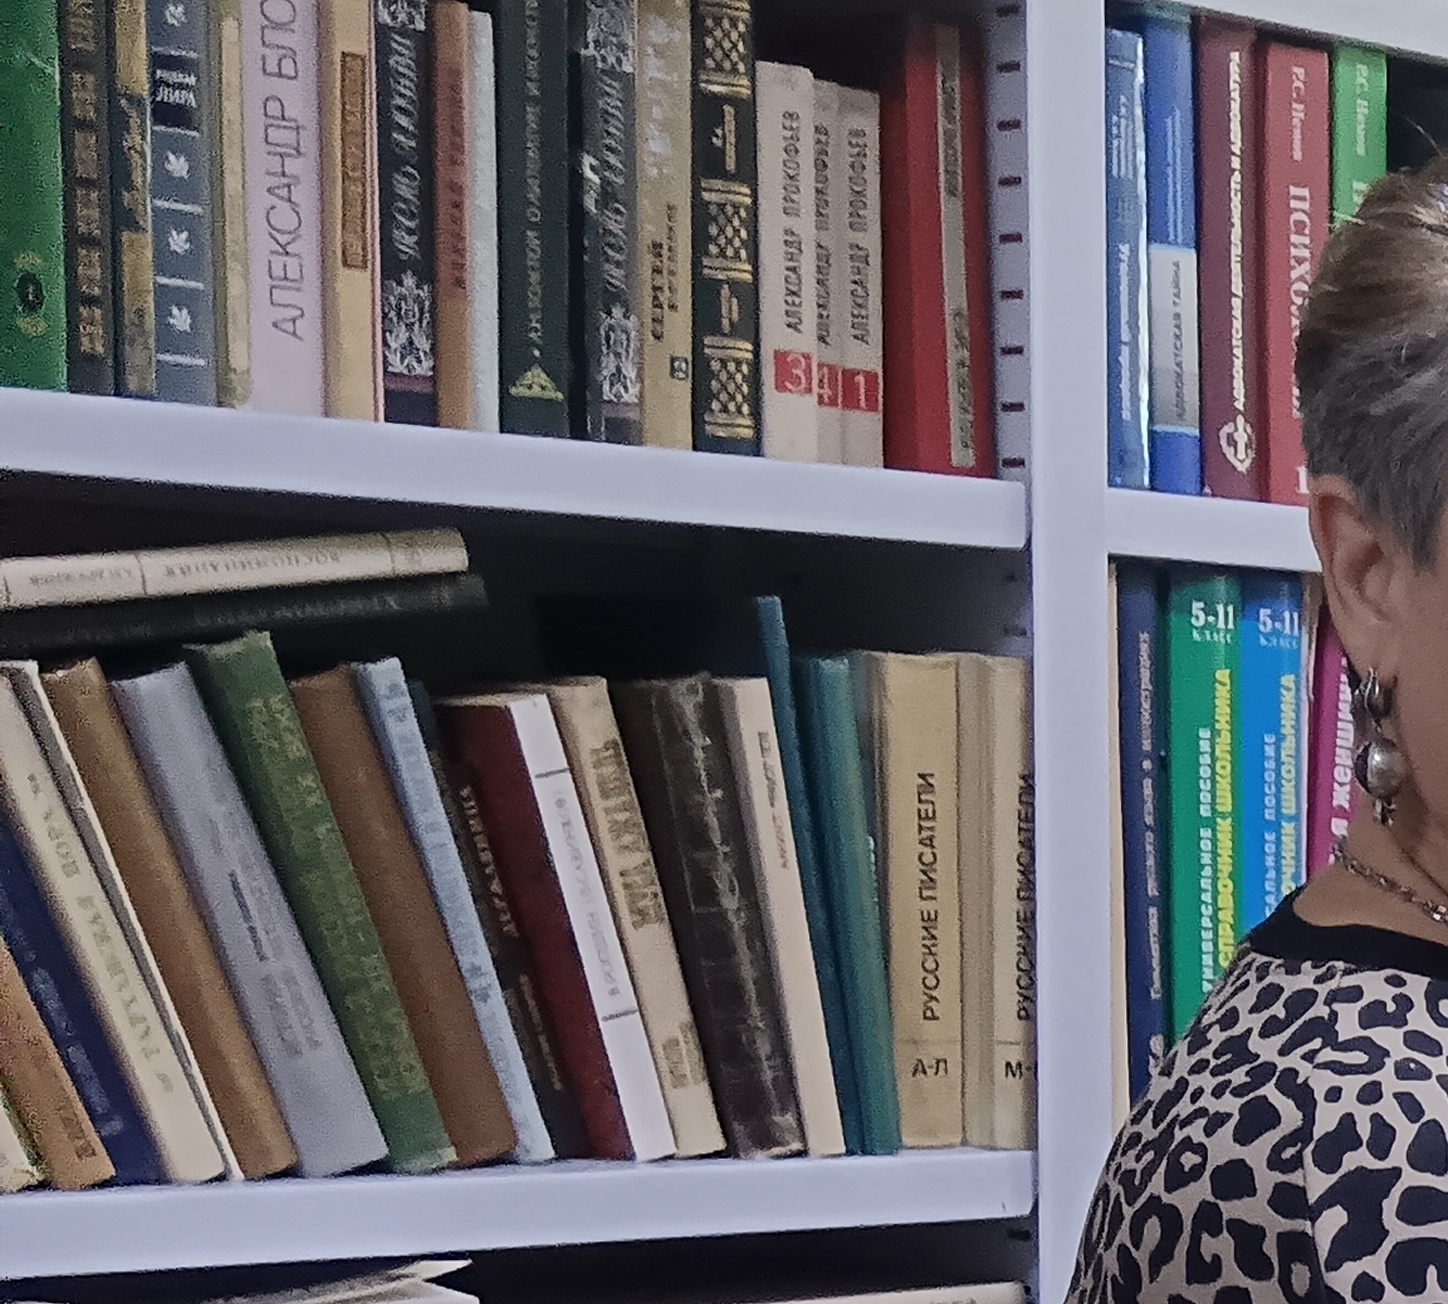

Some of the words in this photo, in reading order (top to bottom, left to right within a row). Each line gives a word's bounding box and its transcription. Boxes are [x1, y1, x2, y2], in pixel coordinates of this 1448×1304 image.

[780, 110, 802, 218] ПРОКОФЬЕВ
[847, 127, 869, 234] ПРОКОФЬЕВ
[264, 94, 306, 343] АЛЕКСАНДР
[782, 228, 803, 334] АЛЕКСАНДР
[849, 242, 870, 346] АЛЕКСАНДР
[1191, 600, 1235, 630] 5-11
[1258, 608, 1300, 637] 5-11
[1198, 727, 1212, 817] ПОСОБИЕ
[1213, 667, 1233, 813] ШКОЛЬНИКА
[1263, 732, 1276, 821] ПОСОБИЕ
[1279, 672, 1297, 815] ШКОЛЬНИКА
[910, 770, 942, 903] ПИСАТЕЛИ
[1264, 829, 1277, 919] САЛЬНОЕ
[1280, 820, 1297, 892] ОЧНИК
[1199, 826, 1214, 992] УНИВЕРСАЛЬНОЕ
[1216, 815, 1236, 967] СПРАВОЧНИК
[916, 906, 946, 1022] РУССКИЕ
[910, 1055, 950, 1080] А-Л
